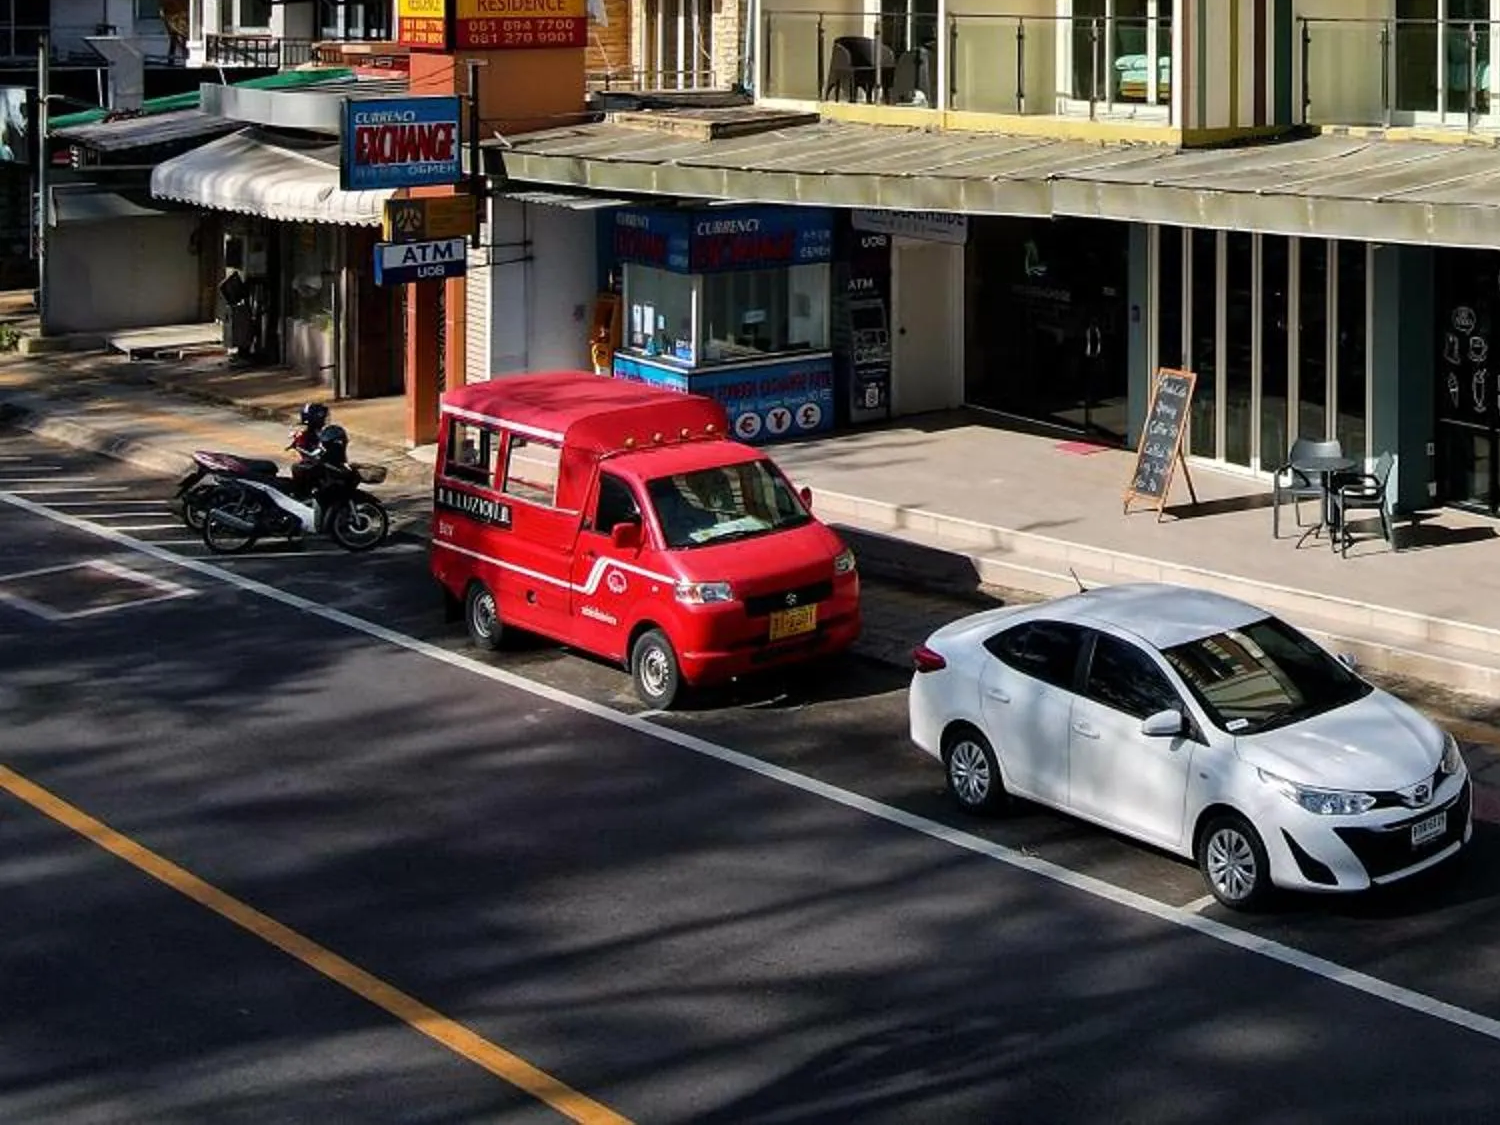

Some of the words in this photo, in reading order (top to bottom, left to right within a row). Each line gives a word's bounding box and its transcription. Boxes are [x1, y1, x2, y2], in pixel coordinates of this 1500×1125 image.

[355, 122, 456, 165] EXCHANGE
[697, 218, 760, 236] CURRENCY
[402, 242, 453, 264] ATM
